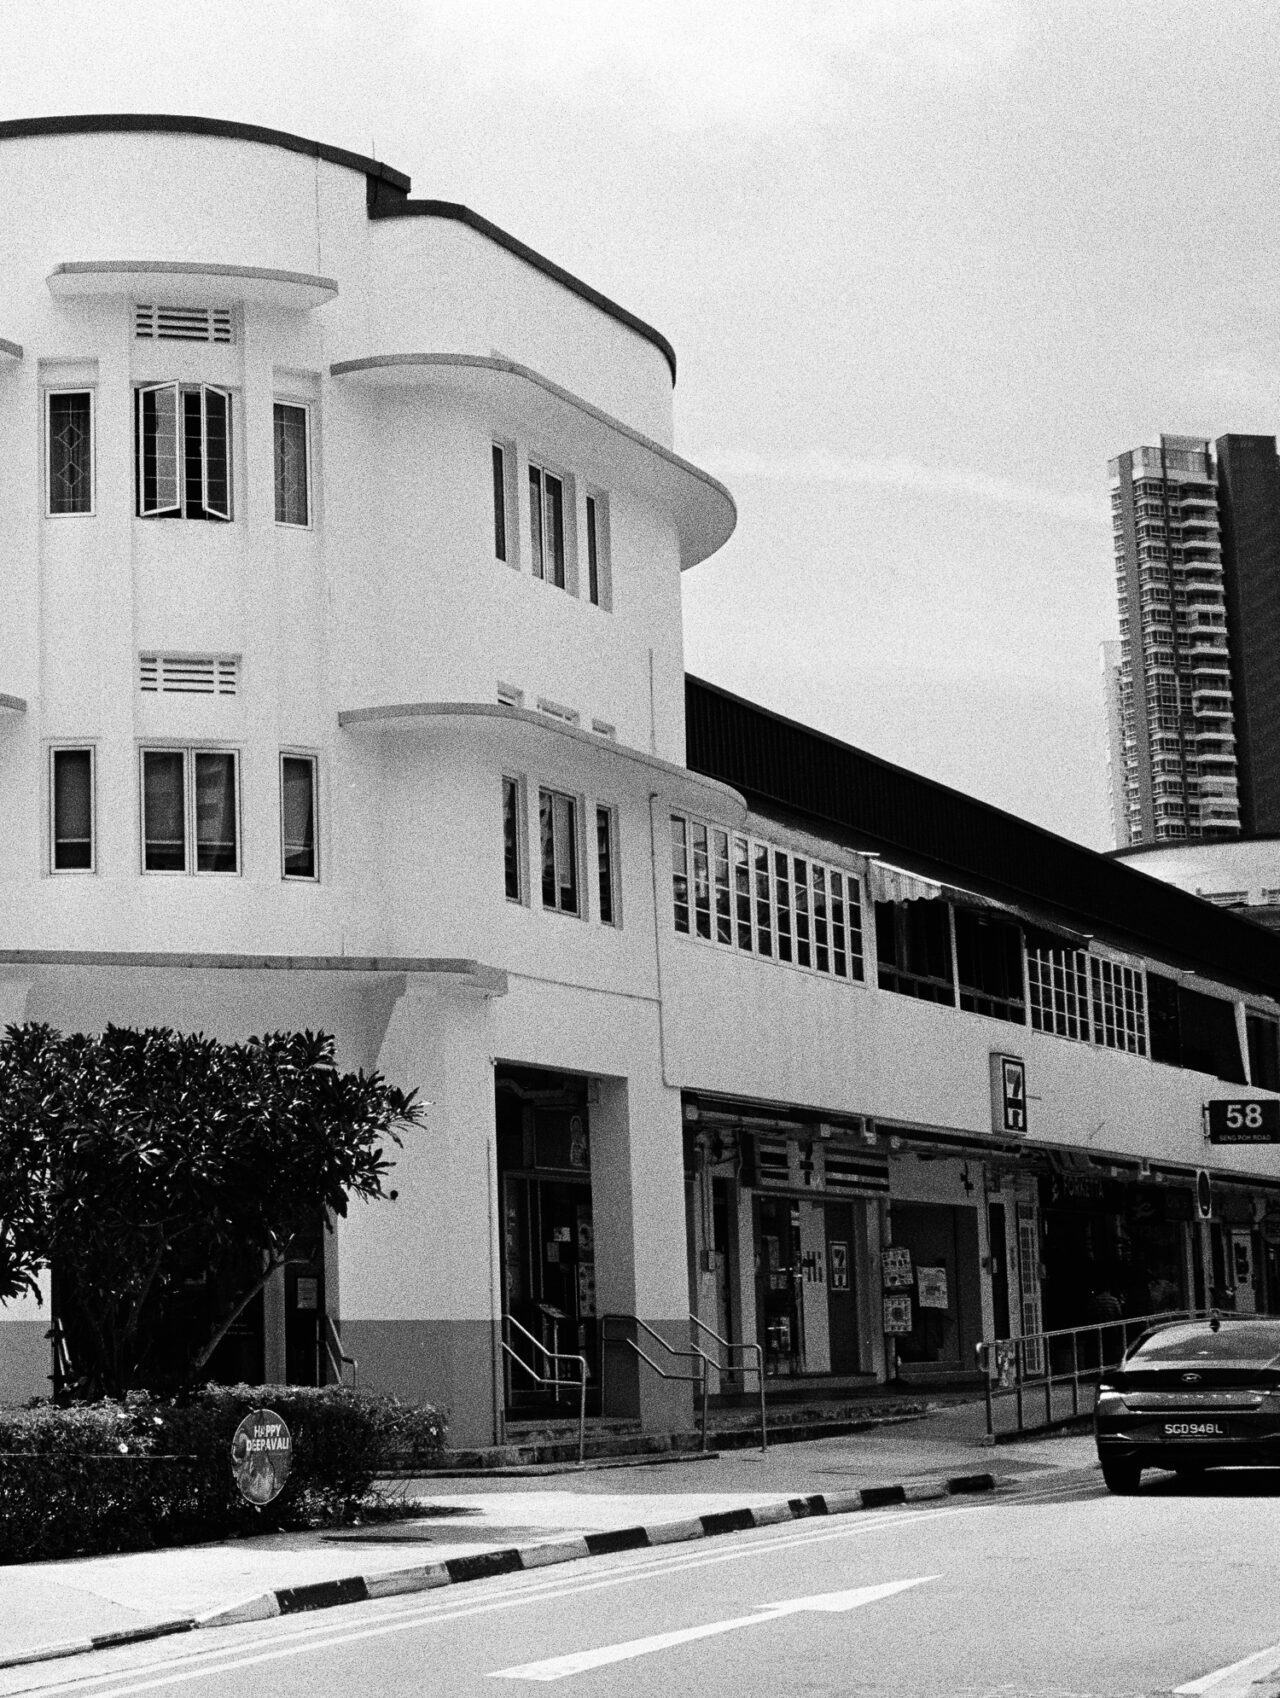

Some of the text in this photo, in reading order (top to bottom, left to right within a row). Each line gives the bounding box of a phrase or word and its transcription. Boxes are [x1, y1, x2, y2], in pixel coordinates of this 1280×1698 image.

[1226, 1103, 1263, 1128] 58
[254, 1424, 281, 1438] HAPPY
[1164, 1423, 1224, 1434] SGD948L
[246, 1437, 290, 1452] DEEPAVALI
